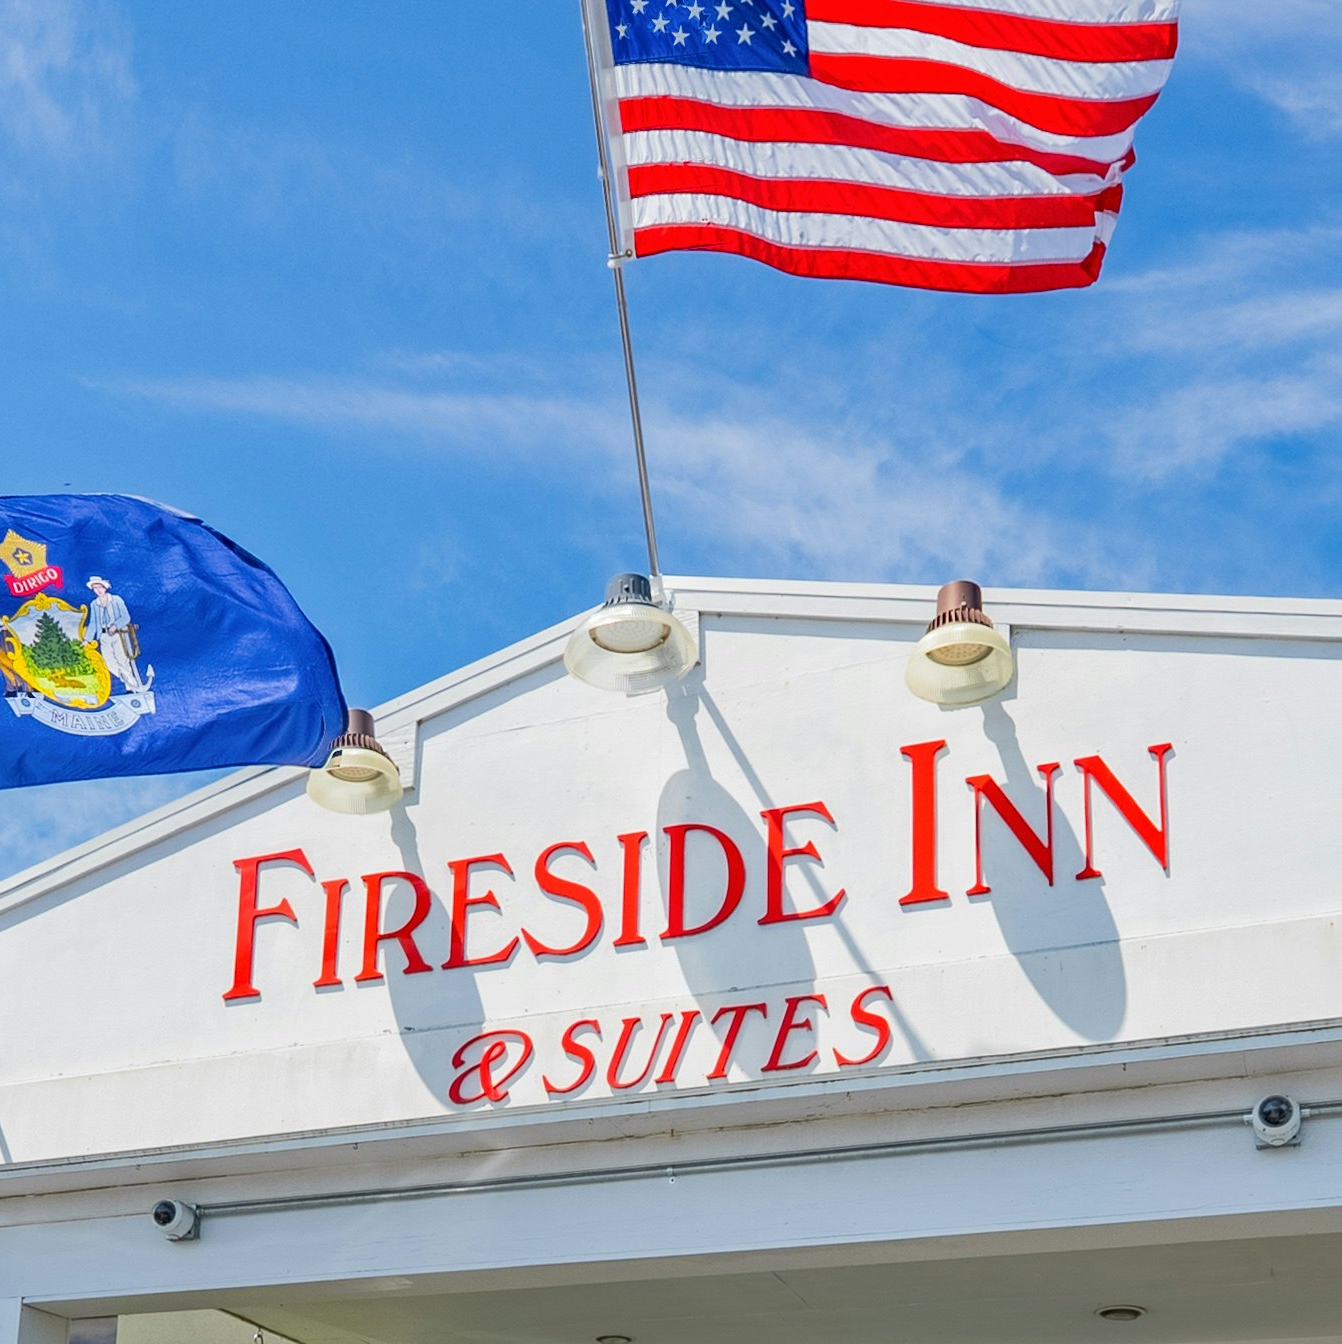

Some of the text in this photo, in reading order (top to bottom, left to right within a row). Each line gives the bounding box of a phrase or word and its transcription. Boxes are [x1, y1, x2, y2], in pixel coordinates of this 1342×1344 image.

[12, 567, 58, 594] DIRIGO
[50, 709, 124, 730] MAINE
[222, 738, 1173, 1001] FIRESIDE INN
[541, 985, 893, 1094] SUITES
